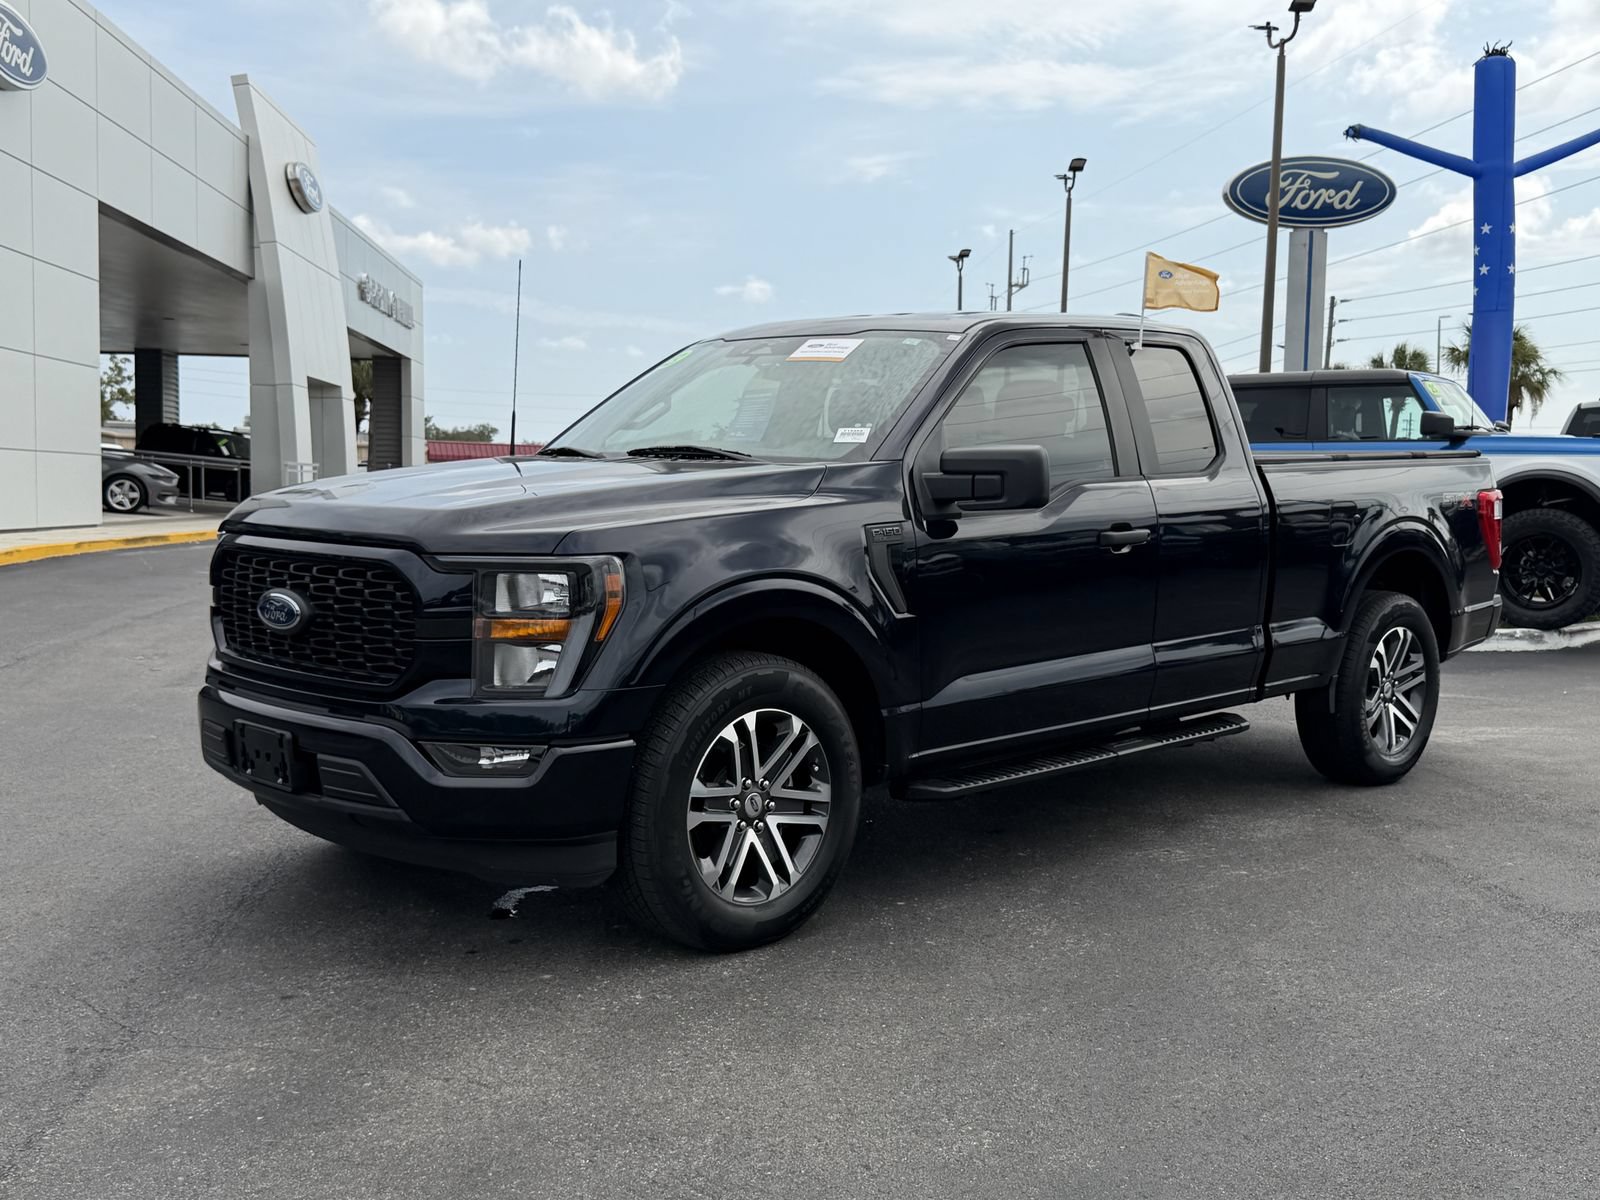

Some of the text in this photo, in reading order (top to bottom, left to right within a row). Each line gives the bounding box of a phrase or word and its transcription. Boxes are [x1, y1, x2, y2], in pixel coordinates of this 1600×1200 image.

[1265, 169, 1364, 210] Ford
[1443, 492, 1472, 509] STX
[264, 600, 288, 622] Ford
